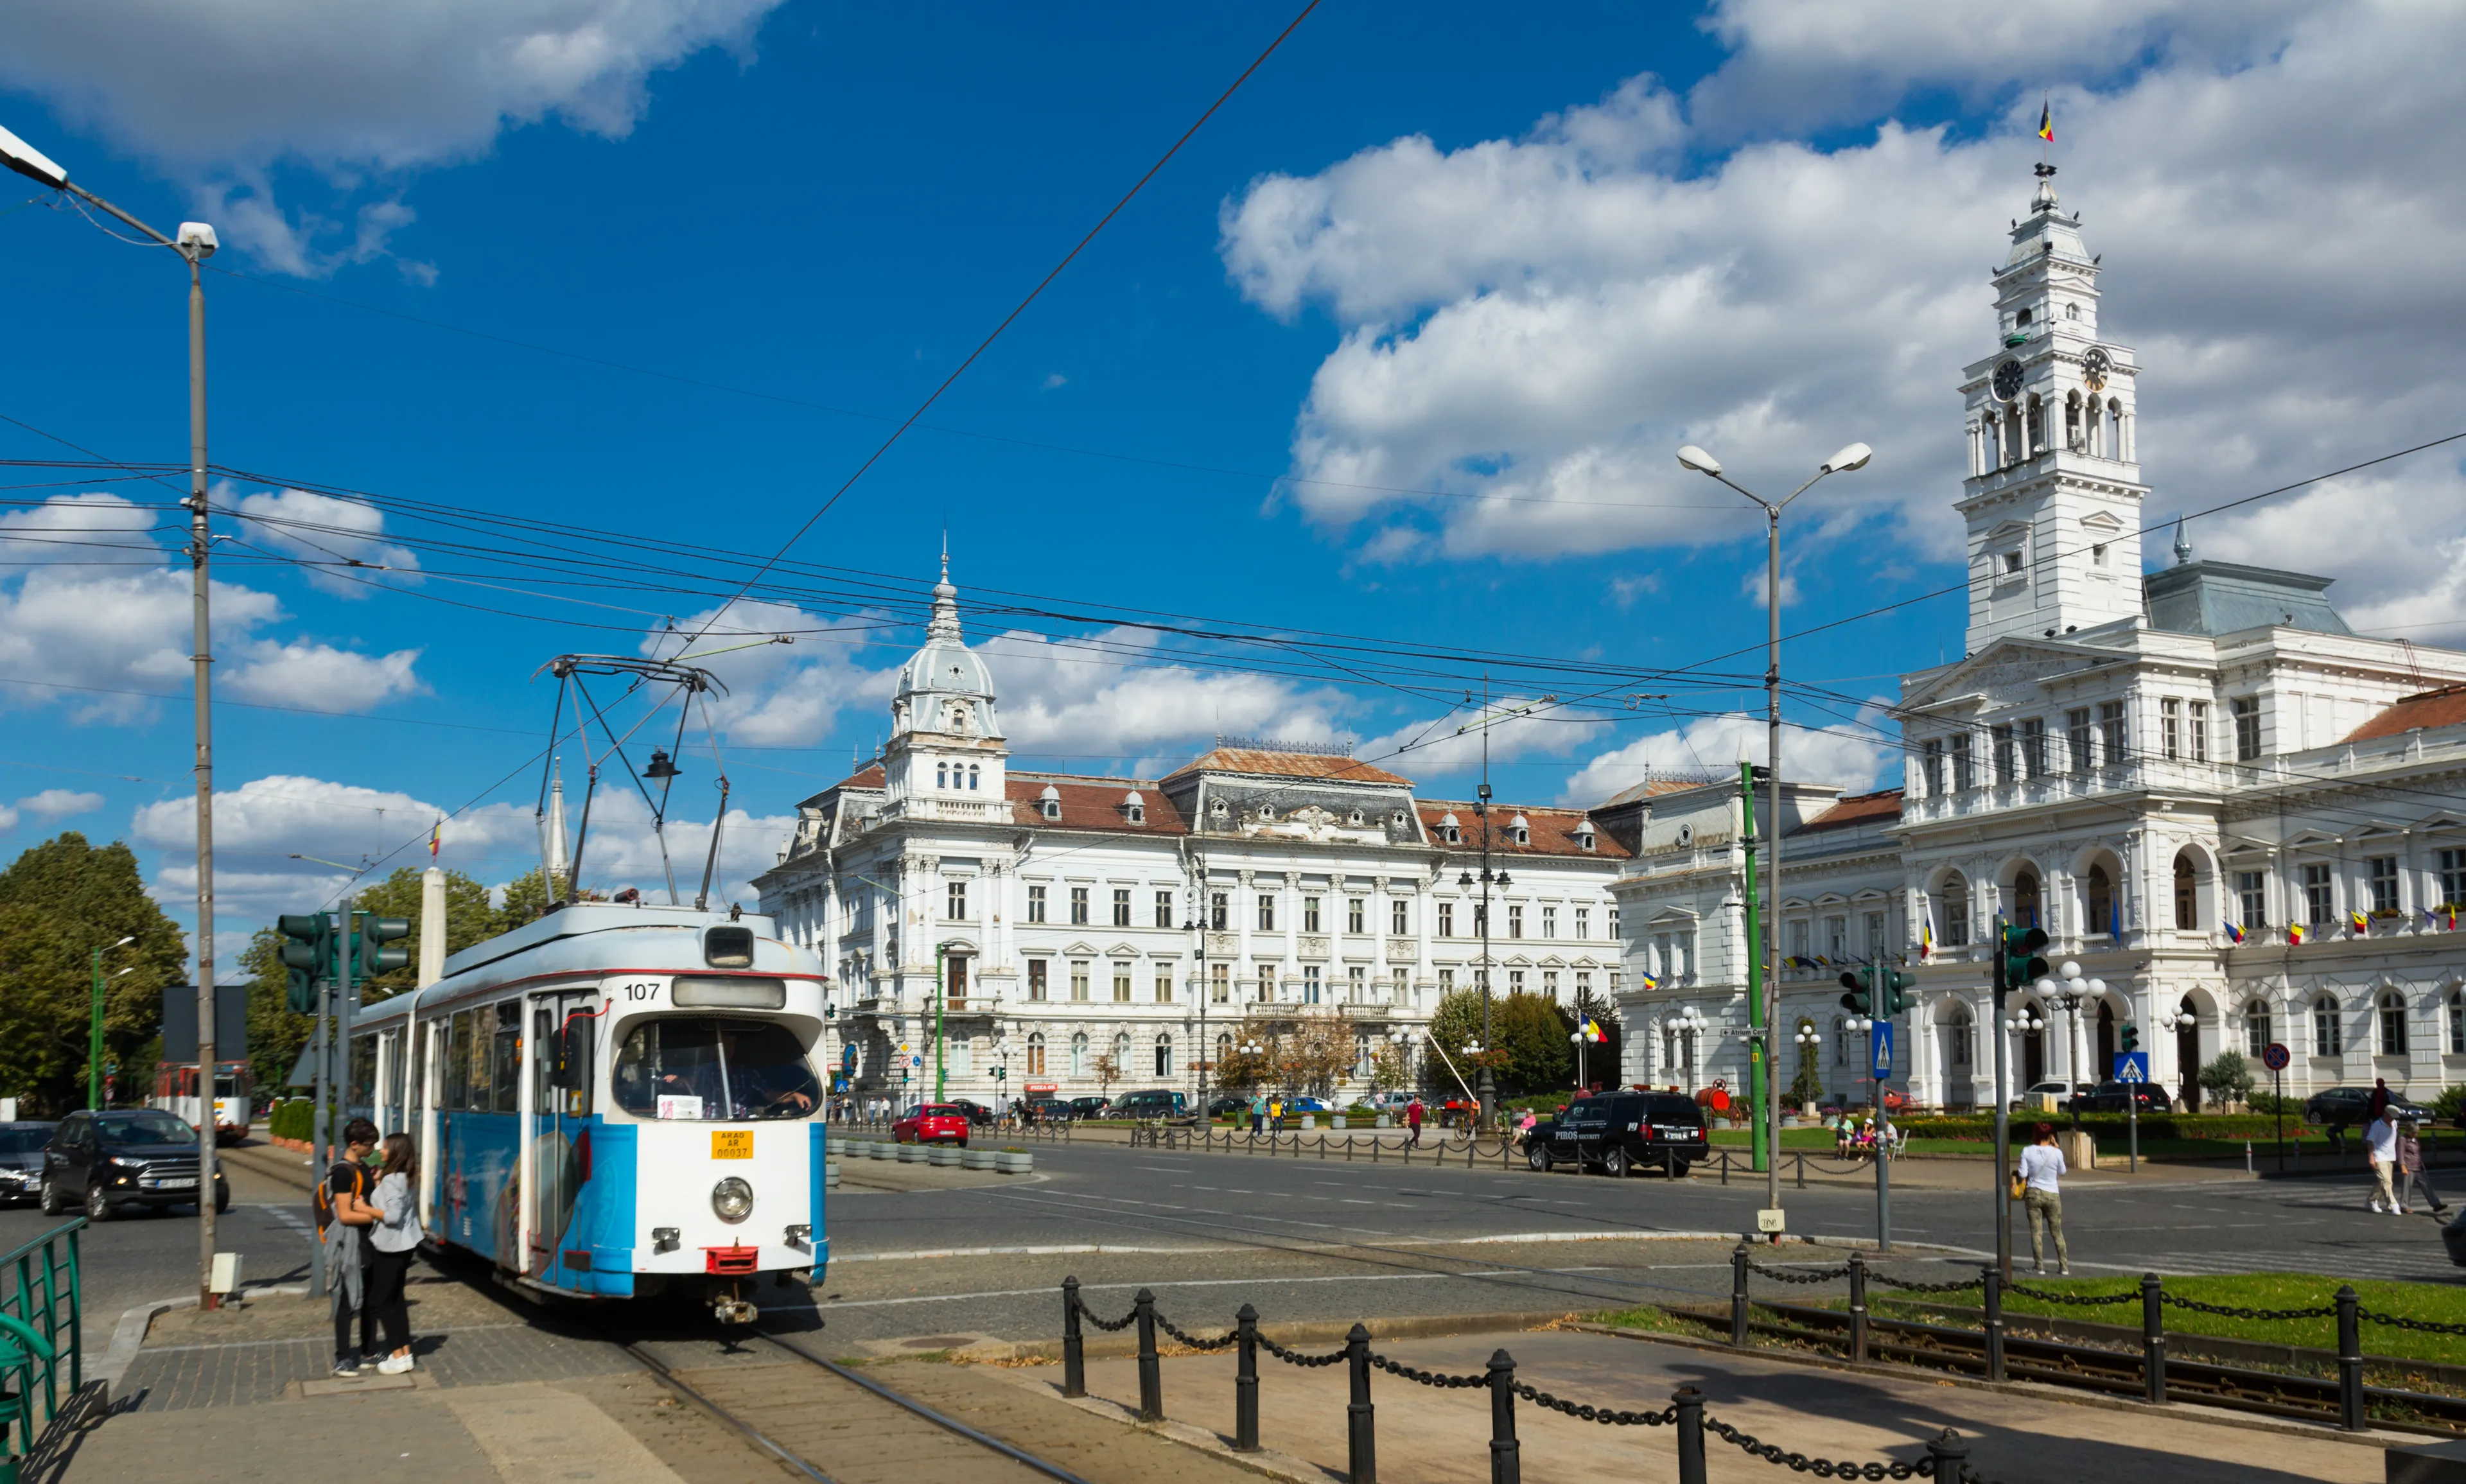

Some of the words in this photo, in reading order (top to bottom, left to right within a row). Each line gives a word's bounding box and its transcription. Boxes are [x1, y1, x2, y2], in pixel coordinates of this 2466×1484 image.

[1995, 683, 2028, 698] ARAD
[624, 983, 660, 1000] 107
[1627, 1122, 1638, 1131] 19
[717, 1148, 748, 1157] 00037
